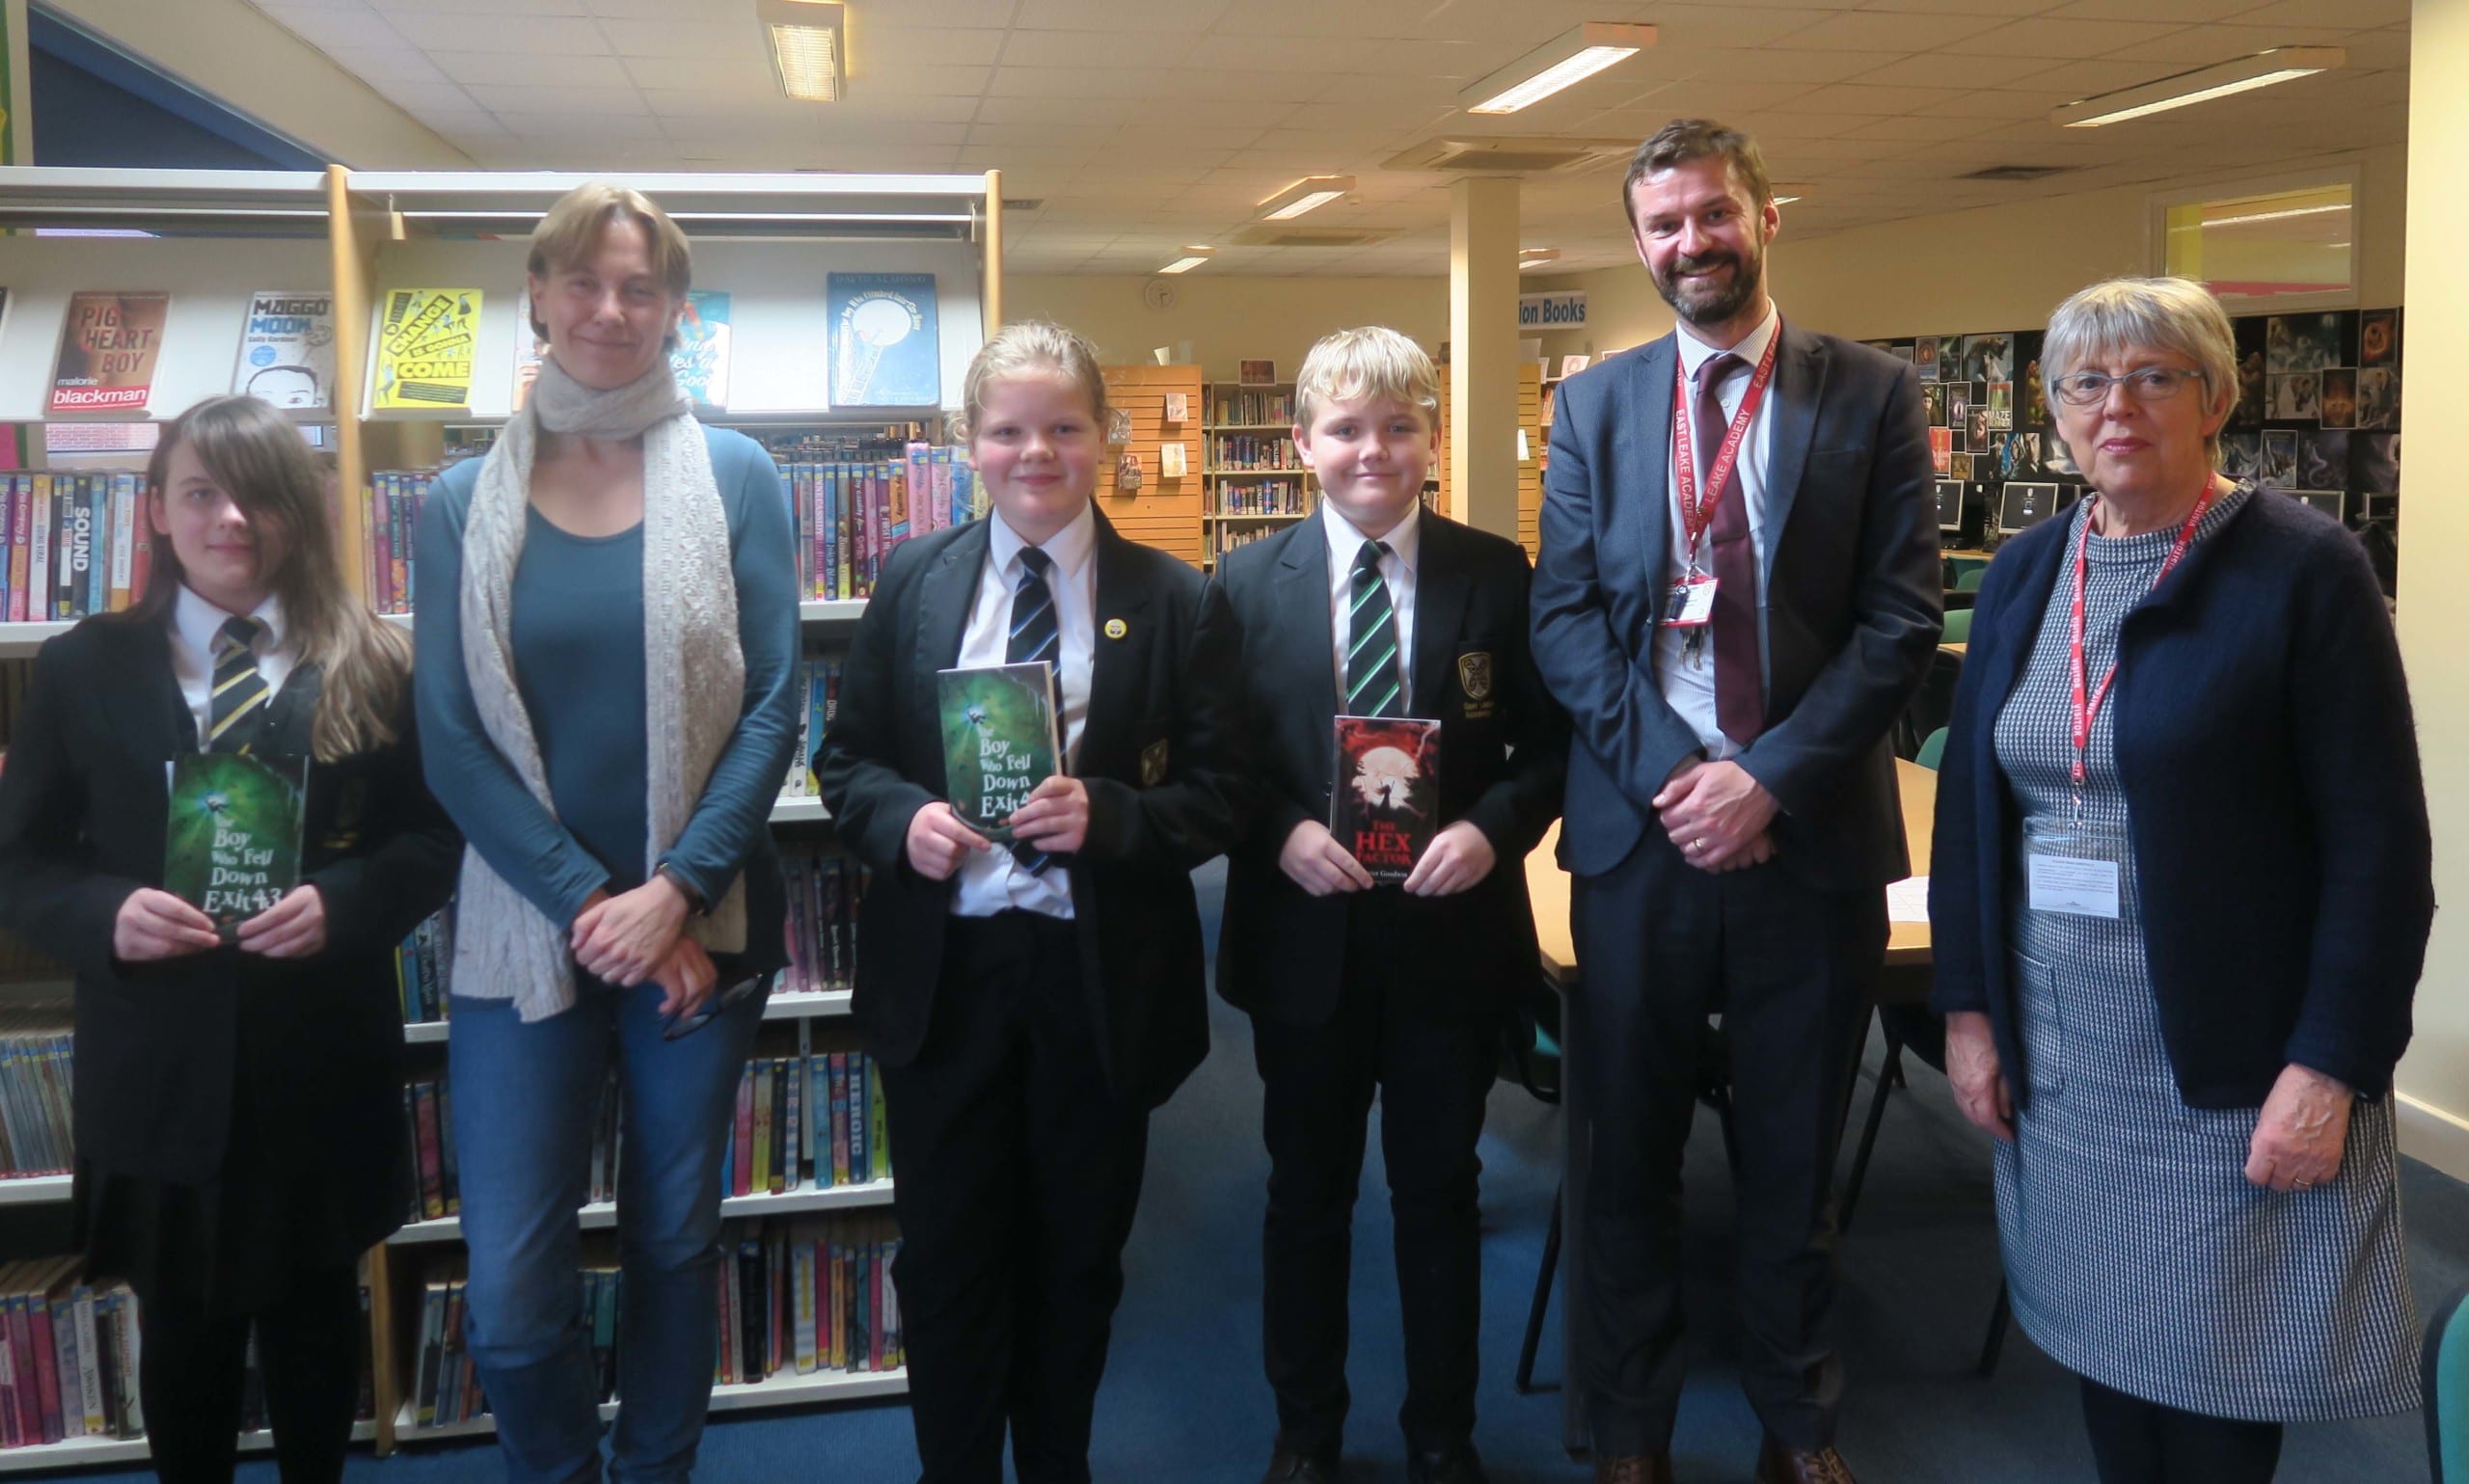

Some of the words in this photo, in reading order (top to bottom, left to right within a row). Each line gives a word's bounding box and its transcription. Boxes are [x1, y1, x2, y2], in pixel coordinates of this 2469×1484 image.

[81, 307, 121, 327] PIG
[1543, 297, 1586, 323] Books
[250, 317, 312, 334] MOON
[387, 294, 453, 356] CHANGE
[85, 330, 152, 349] HEART
[101, 353, 145, 373] BOY
[398, 363, 470, 377] COME
[58, 377, 98, 386] malorie
[1752, 363, 1770, 388] EAST
[54, 390, 147, 404] blackman
[1675, 409, 1687, 436] EAST
[1989, 410, 2011, 419] MAZE
[1677, 436, 1691, 474] LEAKE
[1705, 464, 1727, 503] LEAKE
[1722, 409, 1751, 463] ACADEMY
[2188, 500, 2206, 526] VISITOR
[73, 507, 91, 572] SOUND
[2166, 540, 2185, 571] VISITOR
[2071, 615, 2080, 644] VISITOR
[2072, 658, 2081, 688] VISITOR
[2074, 704, 2082, 736] VISITOR
[980, 738, 1010, 759] Boy
[980, 759, 1002, 771] Who
[1006, 754, 1031, 769] Fell
[983, 774, 1031, 794] Down
[980, 793, 1018, 818] Exit
[1019, 791, 1030, 805] 4
[1372, 820, 1396, 831] THE
[212, 828, 252, 851] Boy
[1356, 831, 1412, 851] HEX
[211, 850, 238, 865] Who
[243, 849, 275, 866] Fell
[1356, 850, 1412, 866] FACTOR
[210, 867, 268, 886] Down
[203, 889, 251, 913] Exit
[252, 887, 283, 910] 43
[850, 1075, 862, 1154] HEROIC
